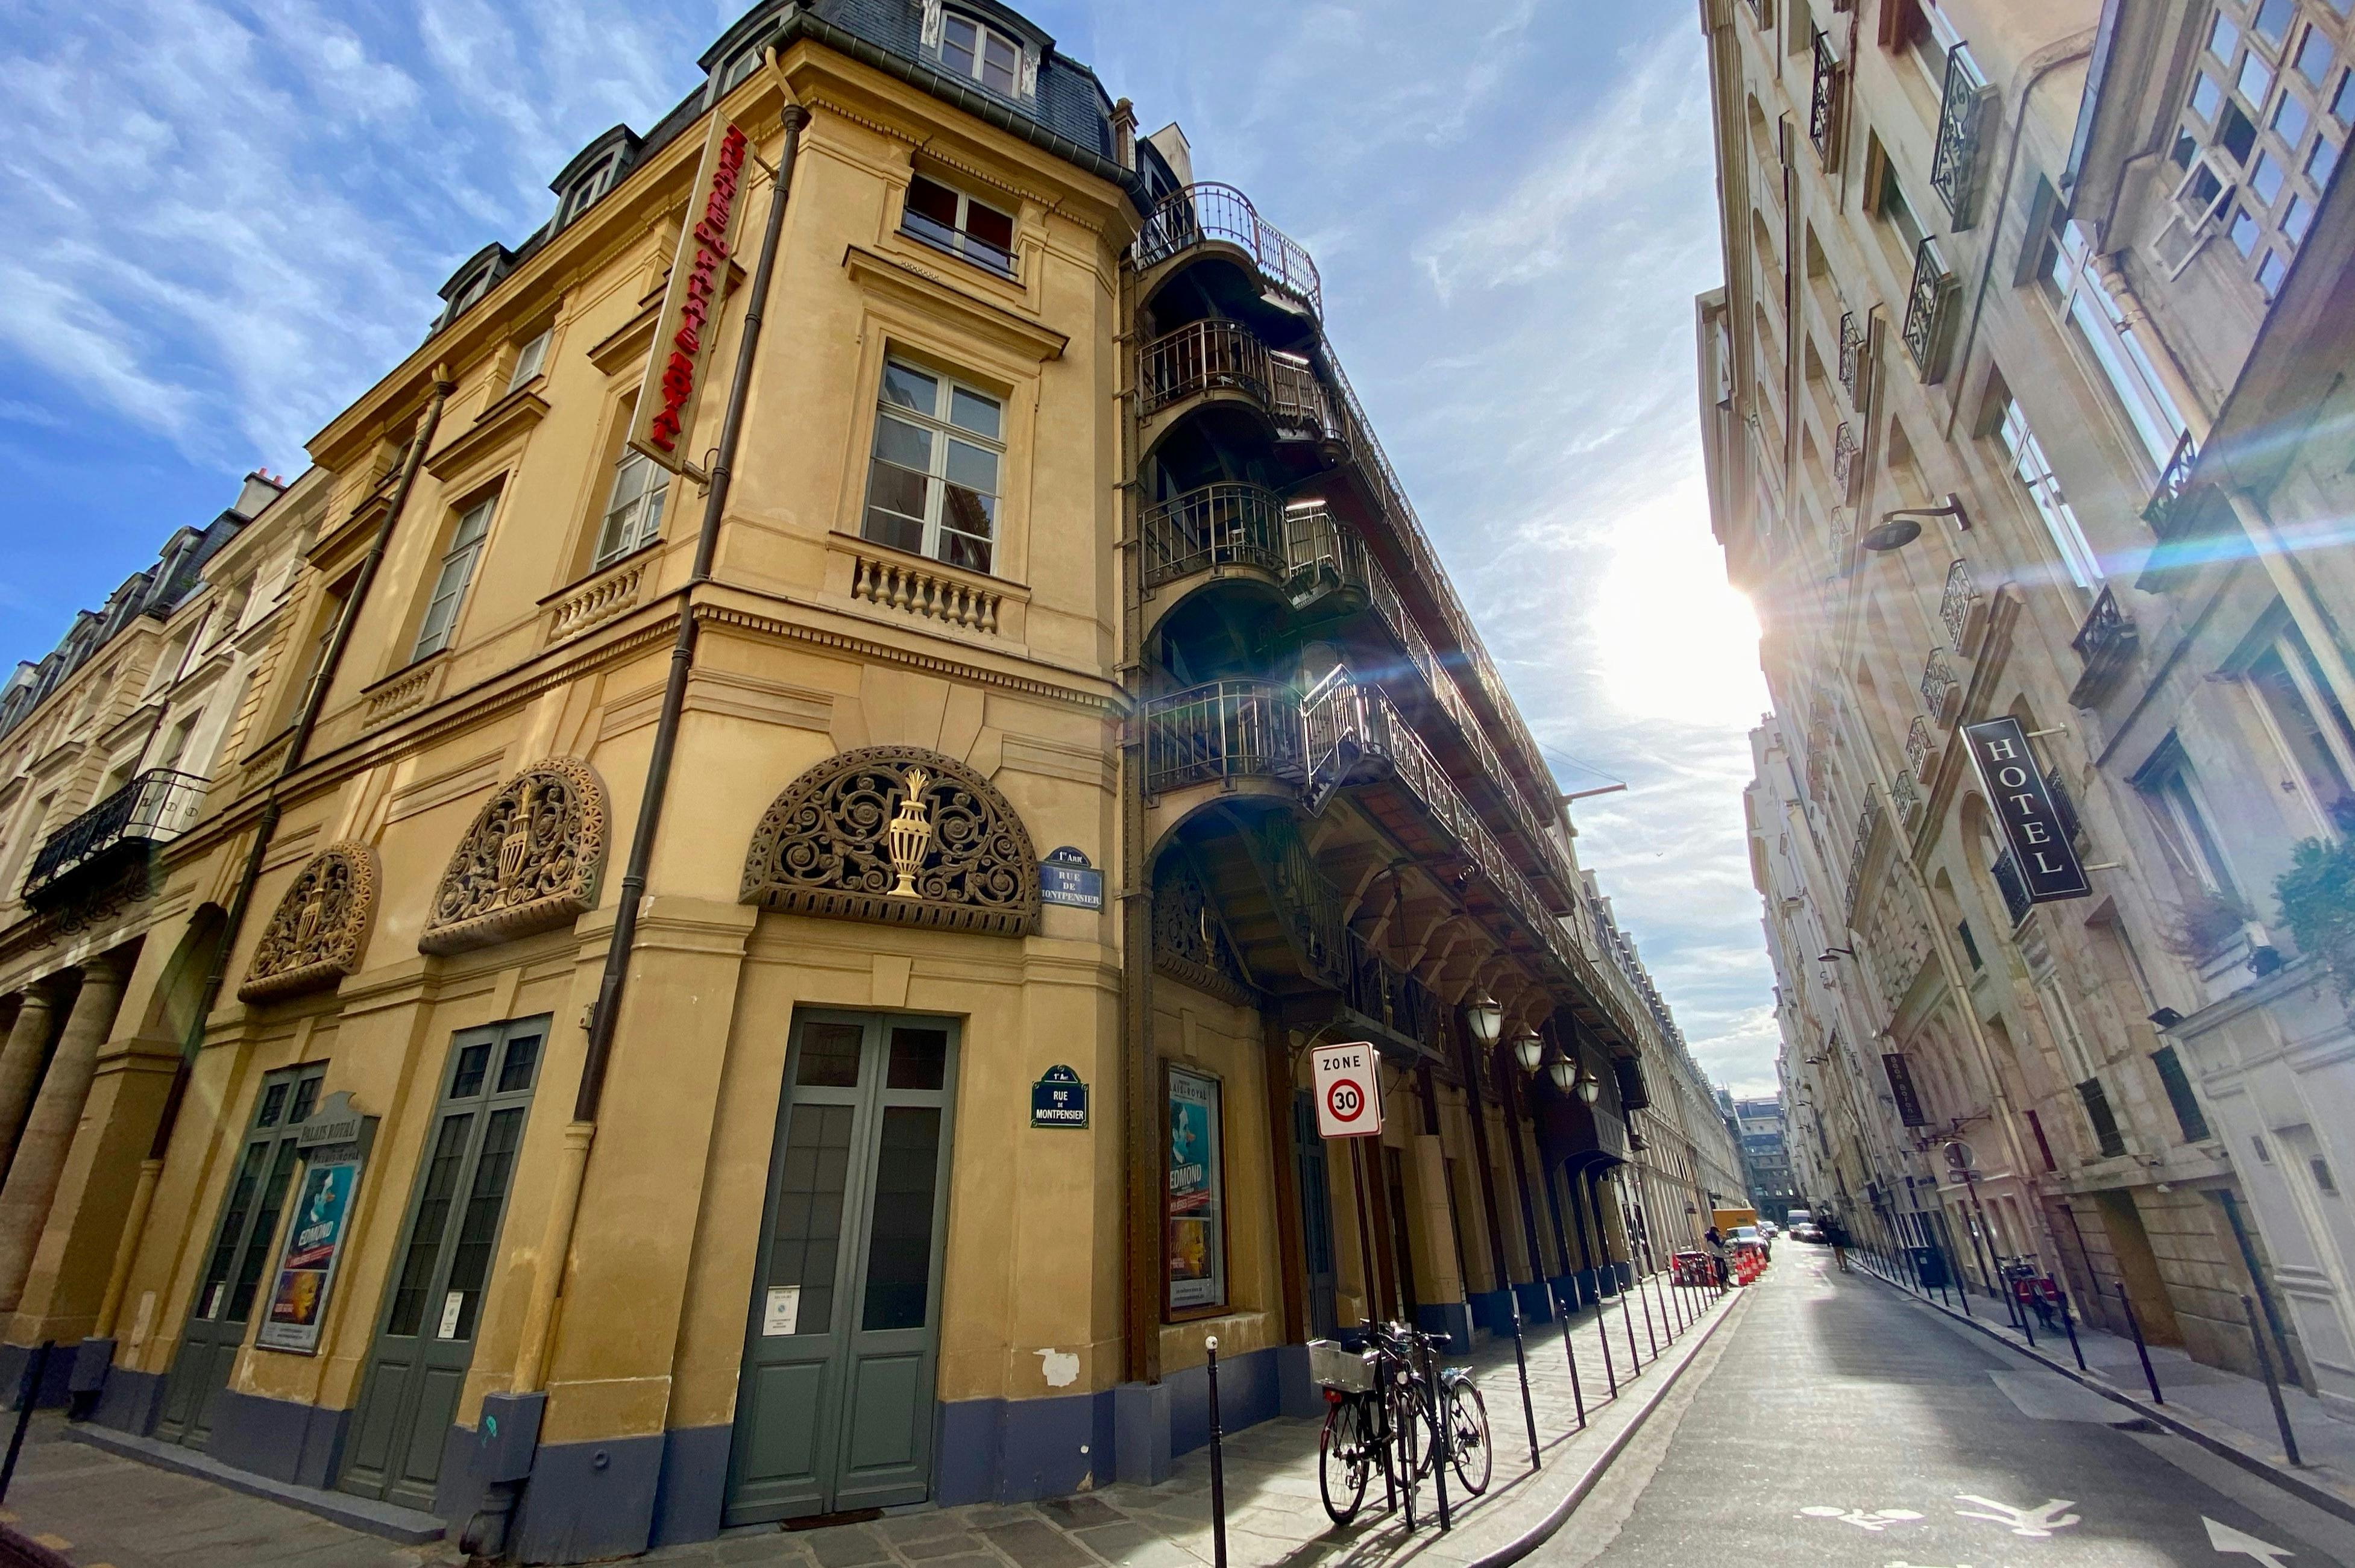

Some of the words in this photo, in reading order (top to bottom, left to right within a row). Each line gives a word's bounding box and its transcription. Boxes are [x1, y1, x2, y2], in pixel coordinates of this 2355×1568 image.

[693, 222, 729, 260] DU
[674, 248, 718, 354] PALAIS
[650, 351, 694, 451] ROYAL
[1986, 738, 2063, 874] HOTEL
[1058, 871, 1080, 882] RUE
[1063, 882, 1075, 891] DE
[1323, 1055, 1360, 1071] ZONE
[1053, 1091, 1068, 1101] RUE
[1335, 1091, 1357, 1110] 30
[1036, 1109, 1084, 1120] MONTPENSIER
[301, 1124, 328, 1143] PALAIS
[327, 1119, 356, 1140] ROYAL
[1170, 1164, 1202, 1190] EDMOND
[298, 1221, 334, 1247] EDMOND
